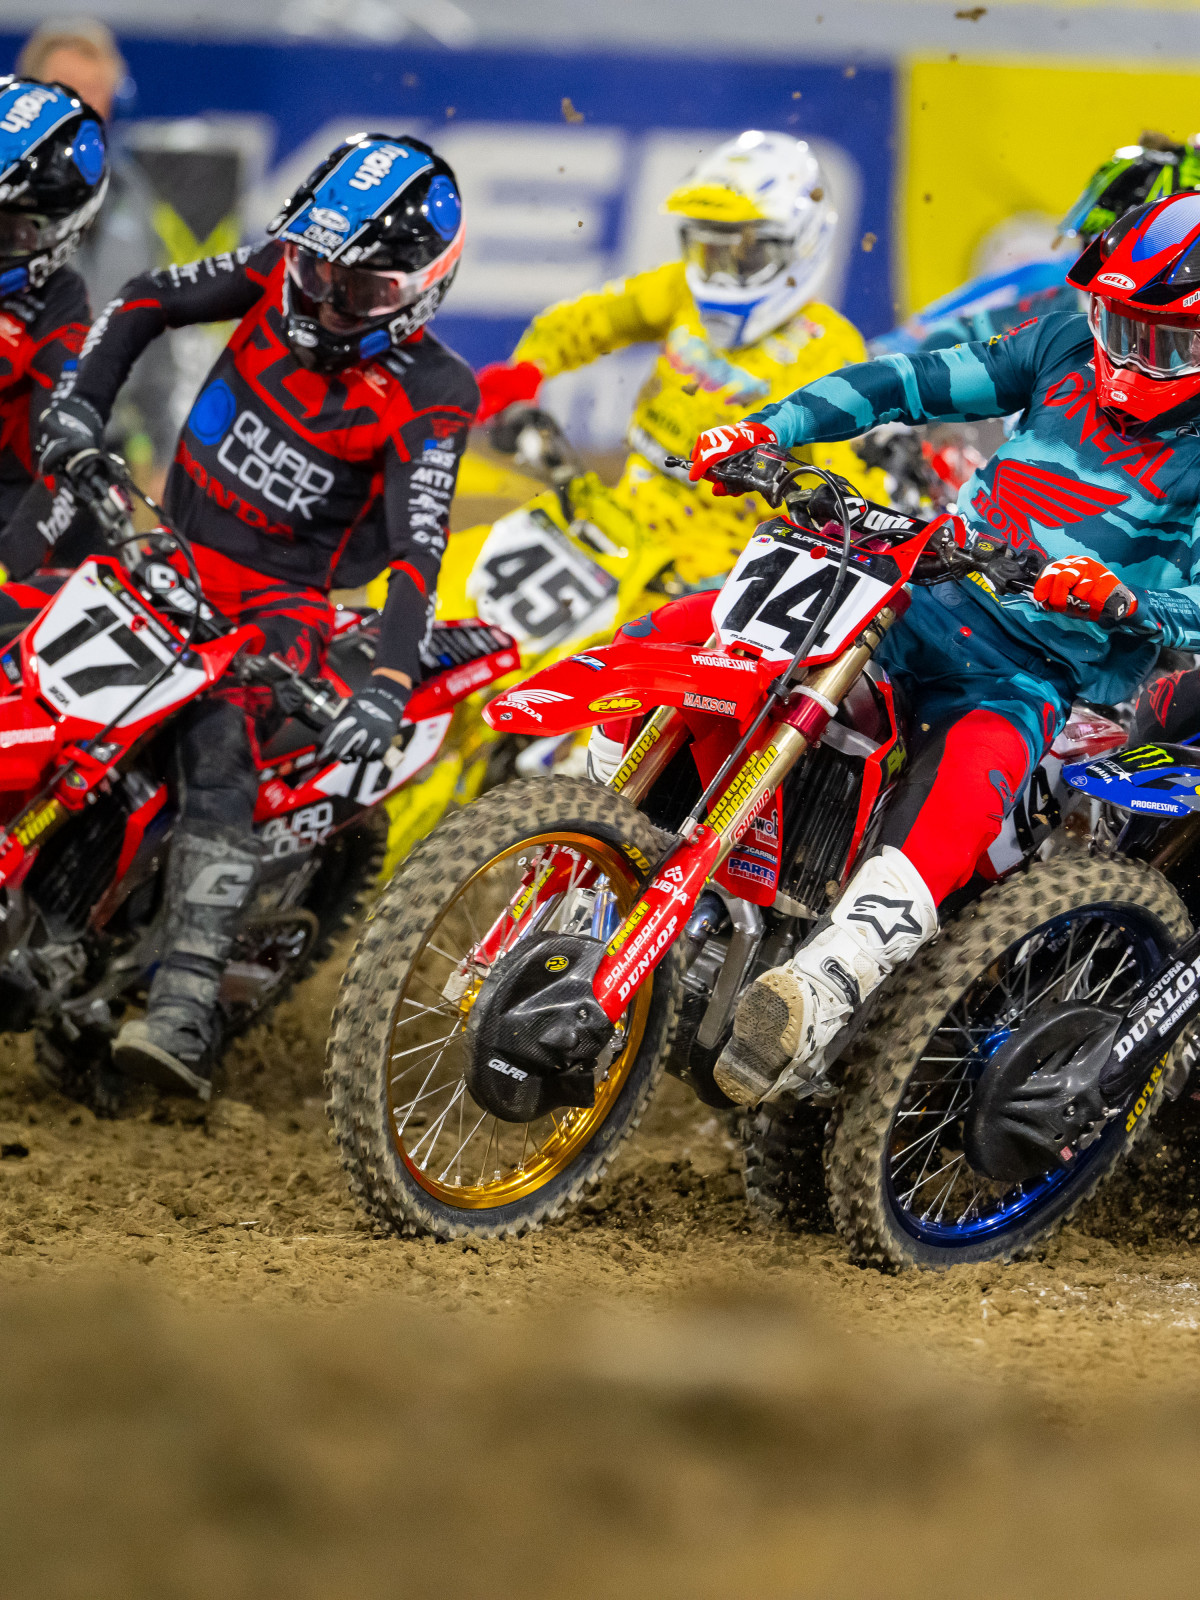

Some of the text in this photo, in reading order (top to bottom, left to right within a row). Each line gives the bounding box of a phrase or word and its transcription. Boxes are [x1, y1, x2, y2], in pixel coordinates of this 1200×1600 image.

[1104, 275, 1129, 289] BELL
[233, 410, 334, 494] QUAD
[217, 434, 320, 520] LOCK
[484, 544, 598, 638] 45
[721, 547, 861, 660] 14
[37, 604, 175, 698] 17
[691, 654, 758, 673] PROGRESSIVE
[496, 699, 543, 724] HONDA
[589, 696, 642, 713] FMF
[683, 693, 737, 715] MAKSON
[1130, 799, 1179, 813] PROGRESSIVE
[728, 858, 775, 882] PARTS
[603, 904, 662, 989] POLISPORT
[606, 901, 651, 957] TAMER
[617, 916, 678, 1002] DUNLOP
[1148, 960, 1186, 999] CYCRA
[1158, 990, 1200, 1037] BRAKING
[487, 1058, 529, 1082] GALFER
